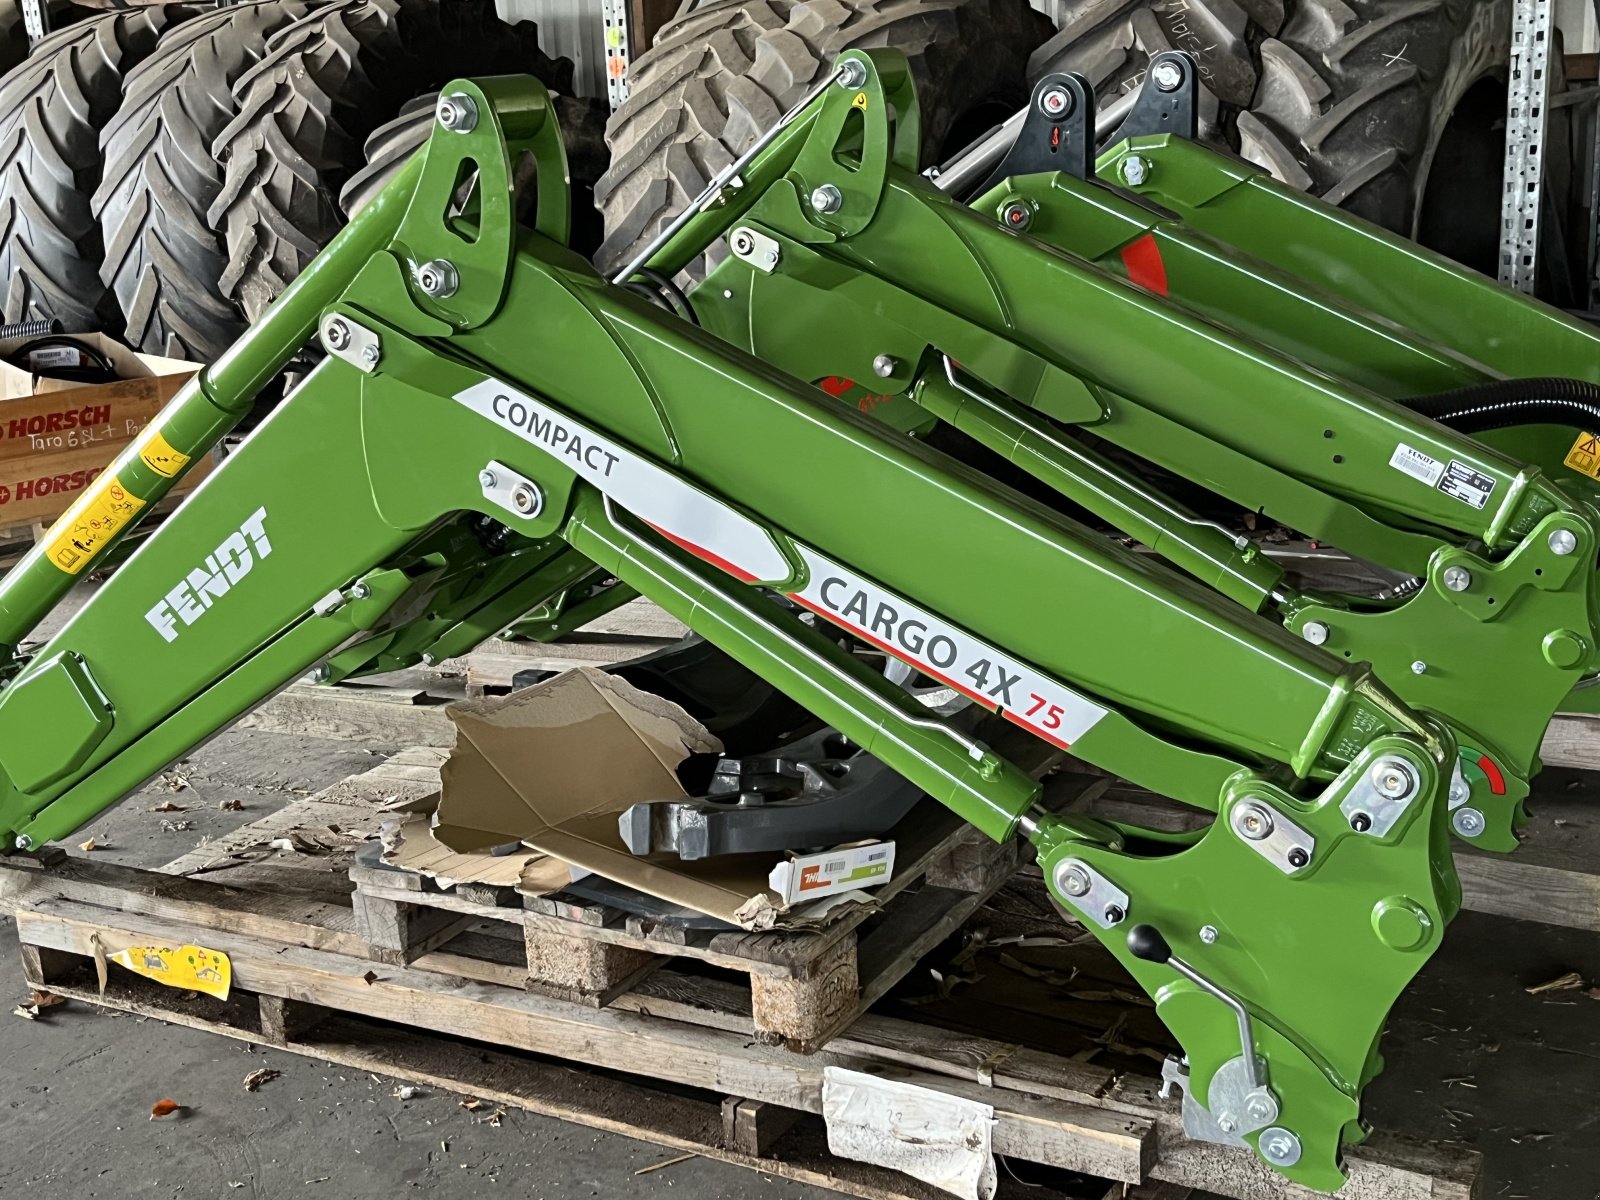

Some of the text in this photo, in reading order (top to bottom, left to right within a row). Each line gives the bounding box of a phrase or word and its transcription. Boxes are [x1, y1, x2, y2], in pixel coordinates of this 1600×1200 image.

[8, 404, 111, 438] HORSCH
[492, 394, 620, 477] COMPACT
[27, 433, 62, 450] Taro
[1408, 449, 1434, 465] FENDT
[15, 466, 108, 501] HORSC
[144, 505, 272, 643] FENDT
[820, 577, 1065, 729] CARGO 4X 75
